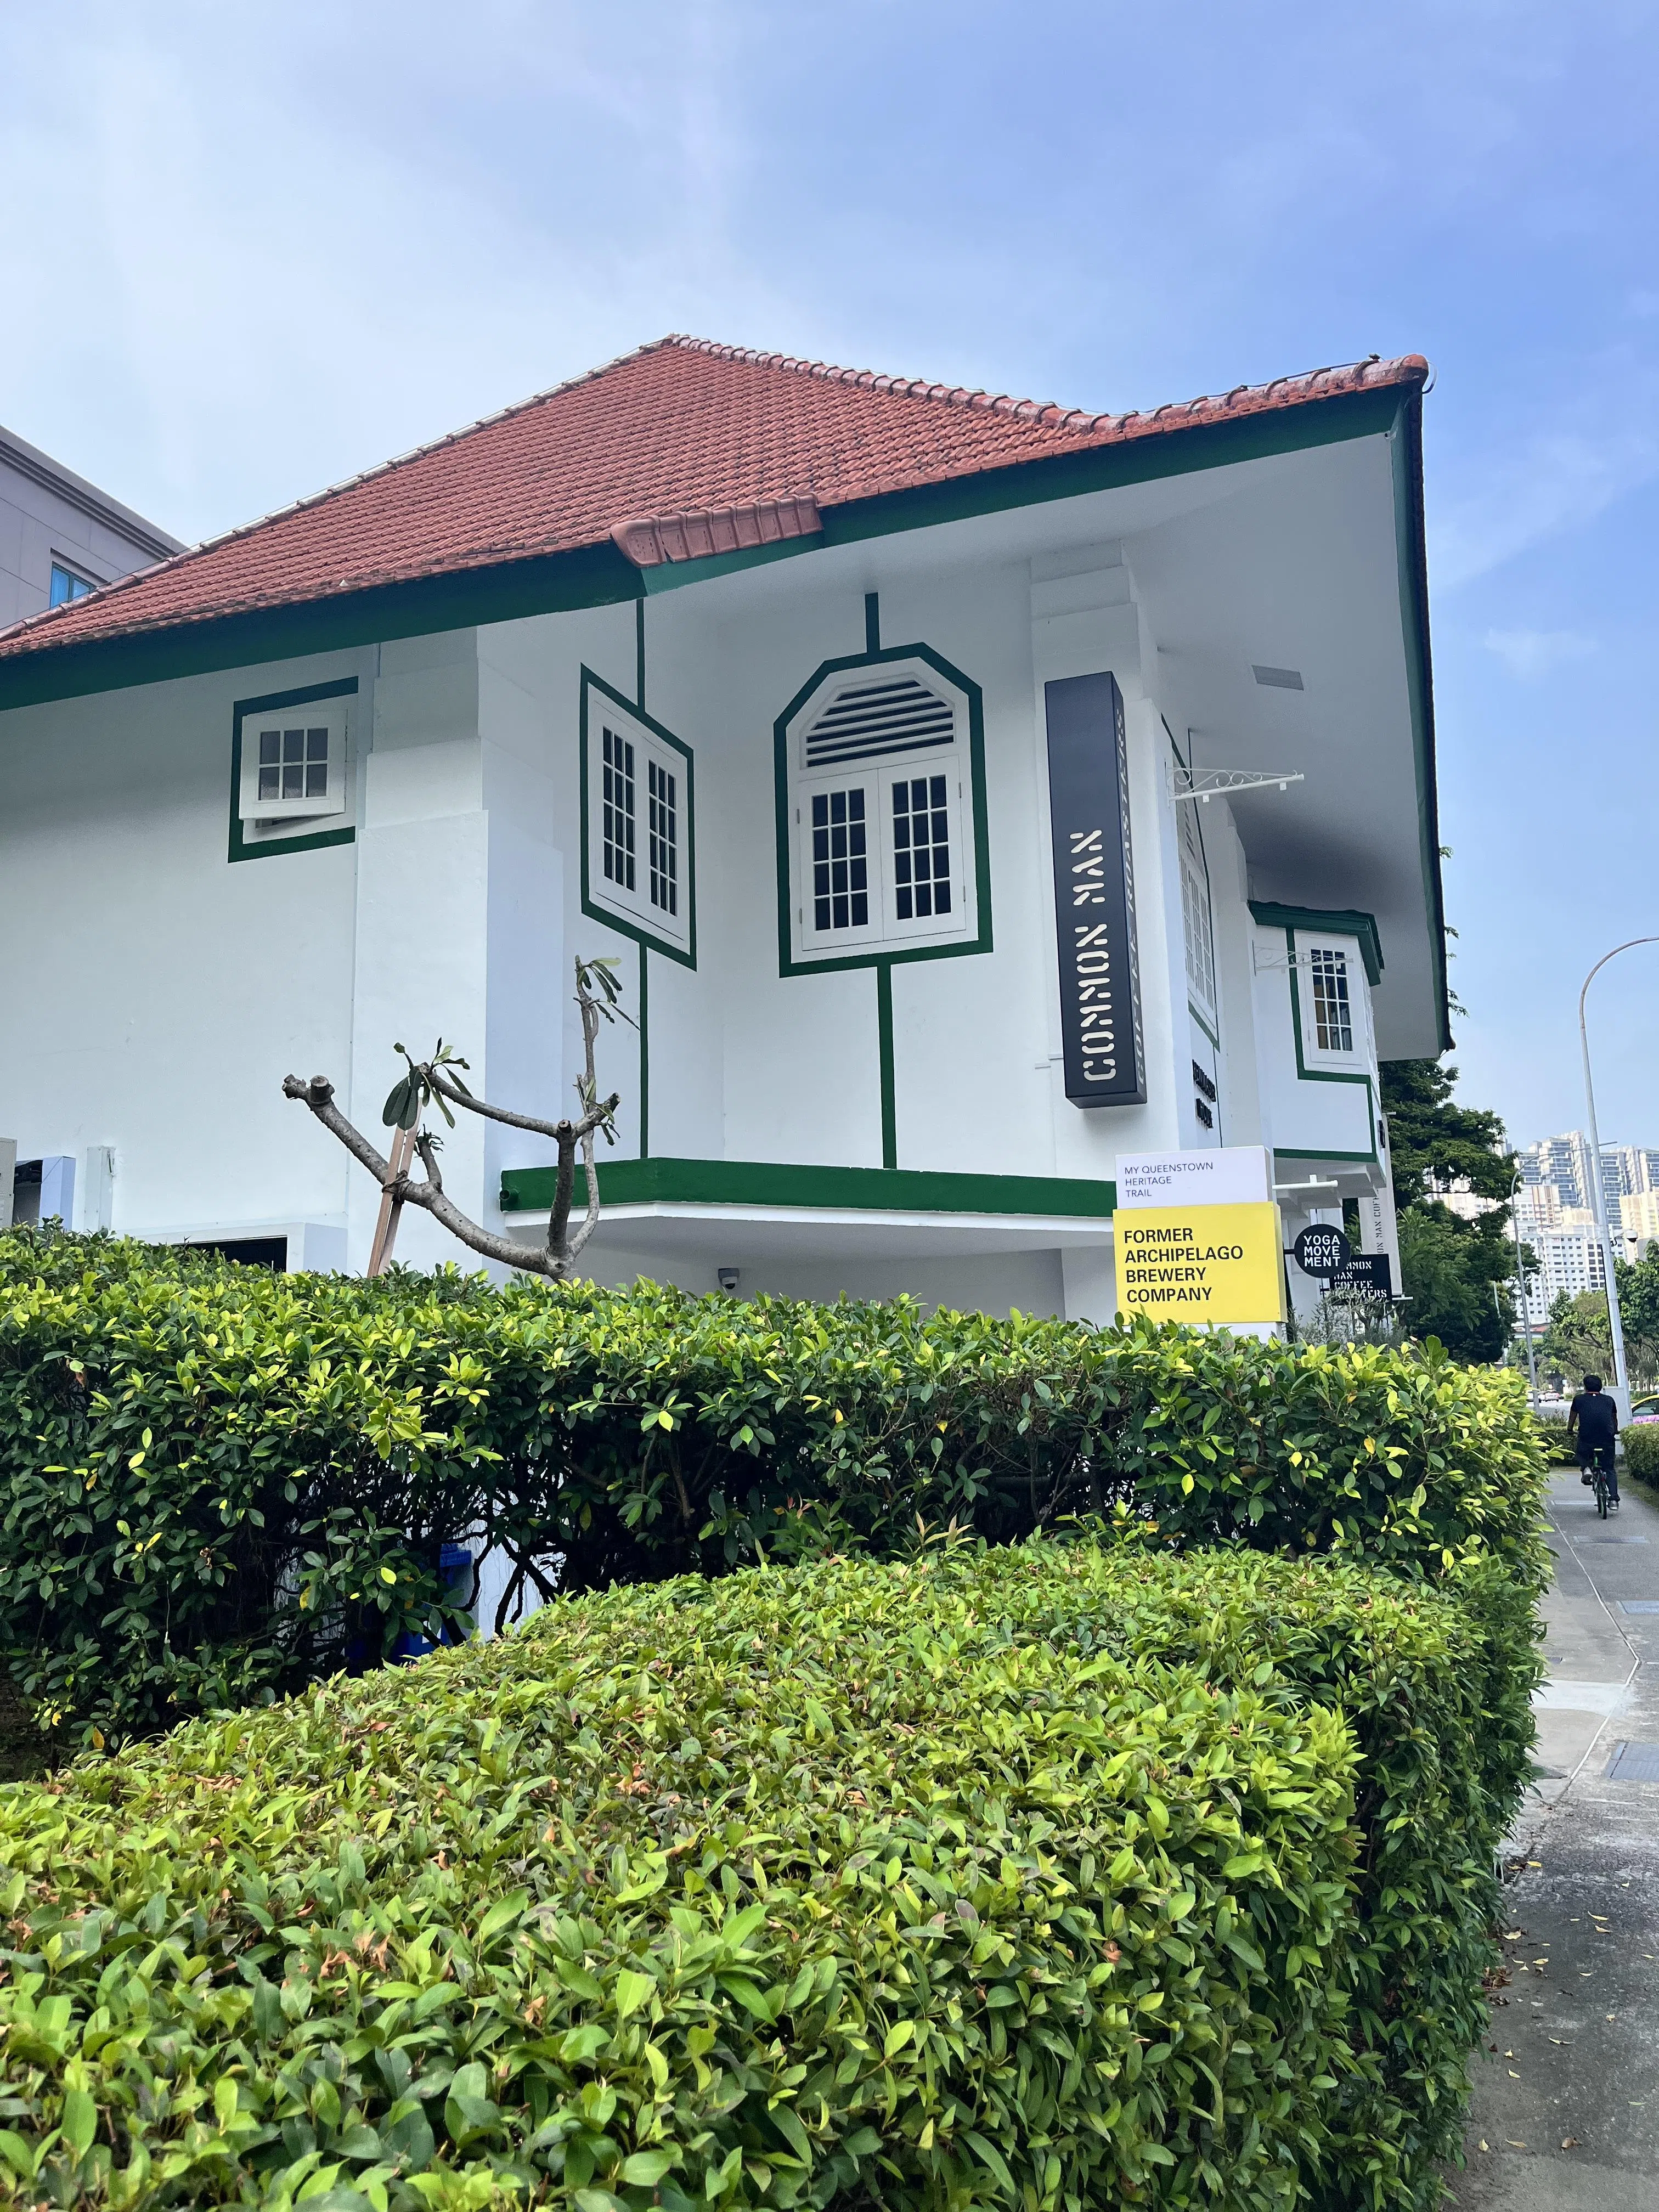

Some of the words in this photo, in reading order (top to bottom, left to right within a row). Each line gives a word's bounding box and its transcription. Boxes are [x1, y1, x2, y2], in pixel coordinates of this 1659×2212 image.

[1116, 708, 1134, 913] ROASTERS
[1069, 830, 1105, 906] MAN
[1074, 923, 1116, 1082] COMMON
[1129, 926, 1144, 1085] COFFEE
[1125, 1166, 1139, 1175] MY
[1142, 1162, 1214, 1174] QUEENSTOWN
[1125, 1176, 1172, 1186] HERITAGE
[1125, 1189, 1152, 1198] TRAIL
[1373, 1189, 1381, 1217] COFF
[1124, 1228, 1193, 1244] FORMER
[1303, 1234, 1340, 1245] YOGA
[1125, 1245, 1243, 1263] ARCHIPELAGO
[1304, 1245, 1340, 1256] MOVE
[1304, 1256, 1341, 1267] MENT
[1346, 1261, 1372, 1270] MMON
[1126, 1267, 1206, 1283] BREWERY
[1127, 1287, 1212, 1303] COMPANY
